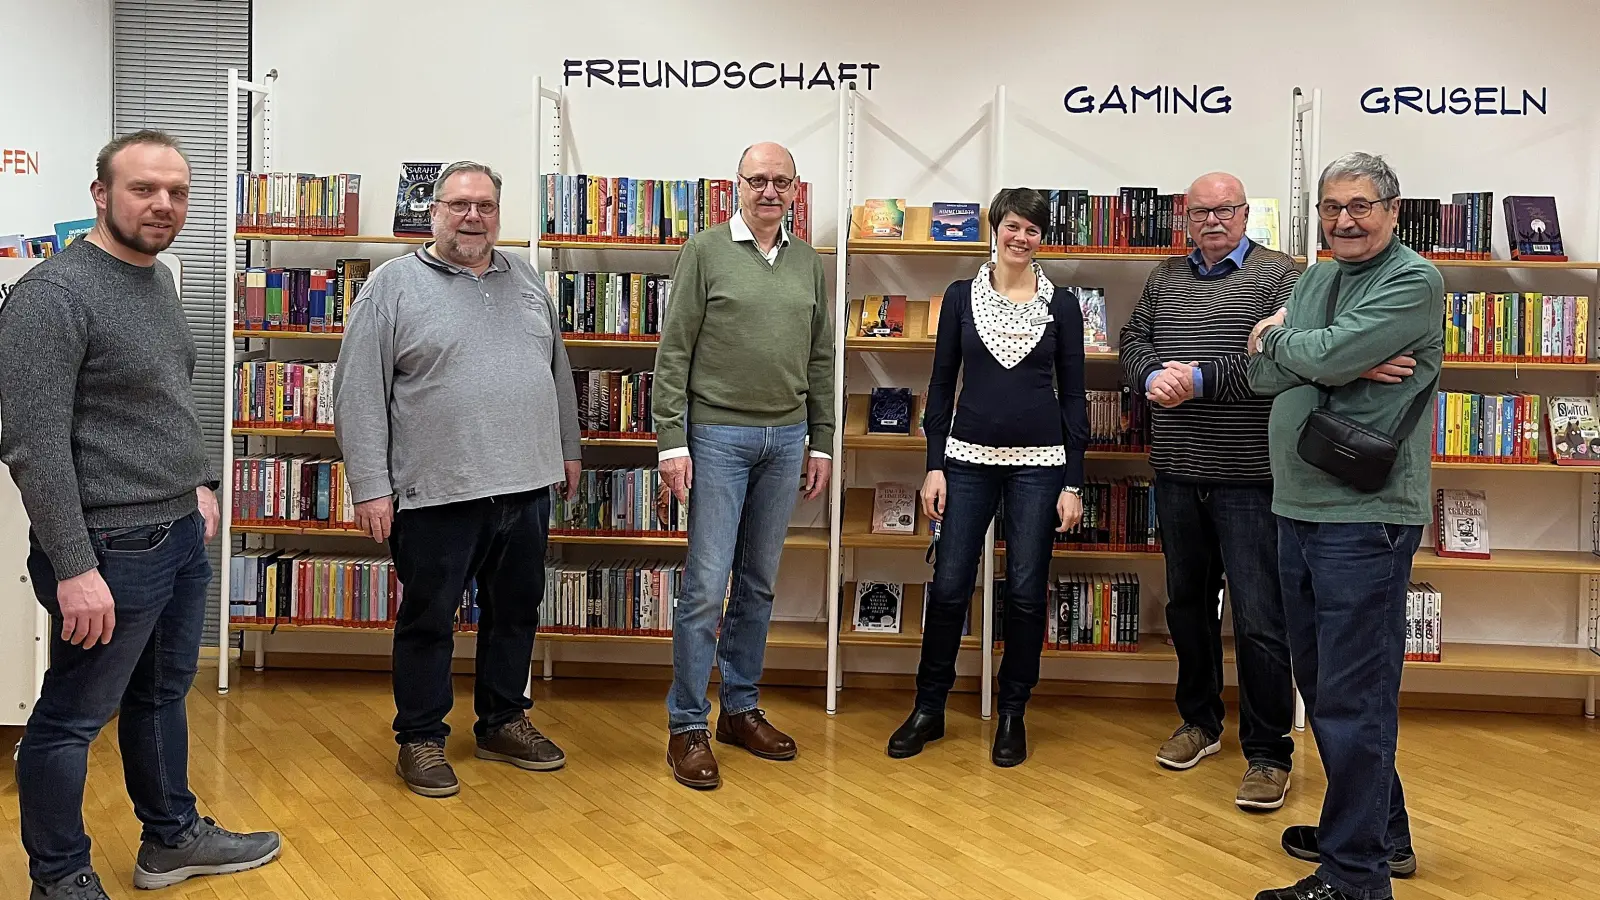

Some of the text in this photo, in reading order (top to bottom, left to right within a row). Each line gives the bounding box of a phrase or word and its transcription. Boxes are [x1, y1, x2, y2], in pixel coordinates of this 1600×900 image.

[563, 59, 881, 91] FREUNDSCHAFT
[1064, 84, 1233, 115] GAMING
[1360, 86, 1547, 116] GRUSELN
[408, 166, 433, 174] SARAH
[1557, 402, 1589, 417] SWITCH
